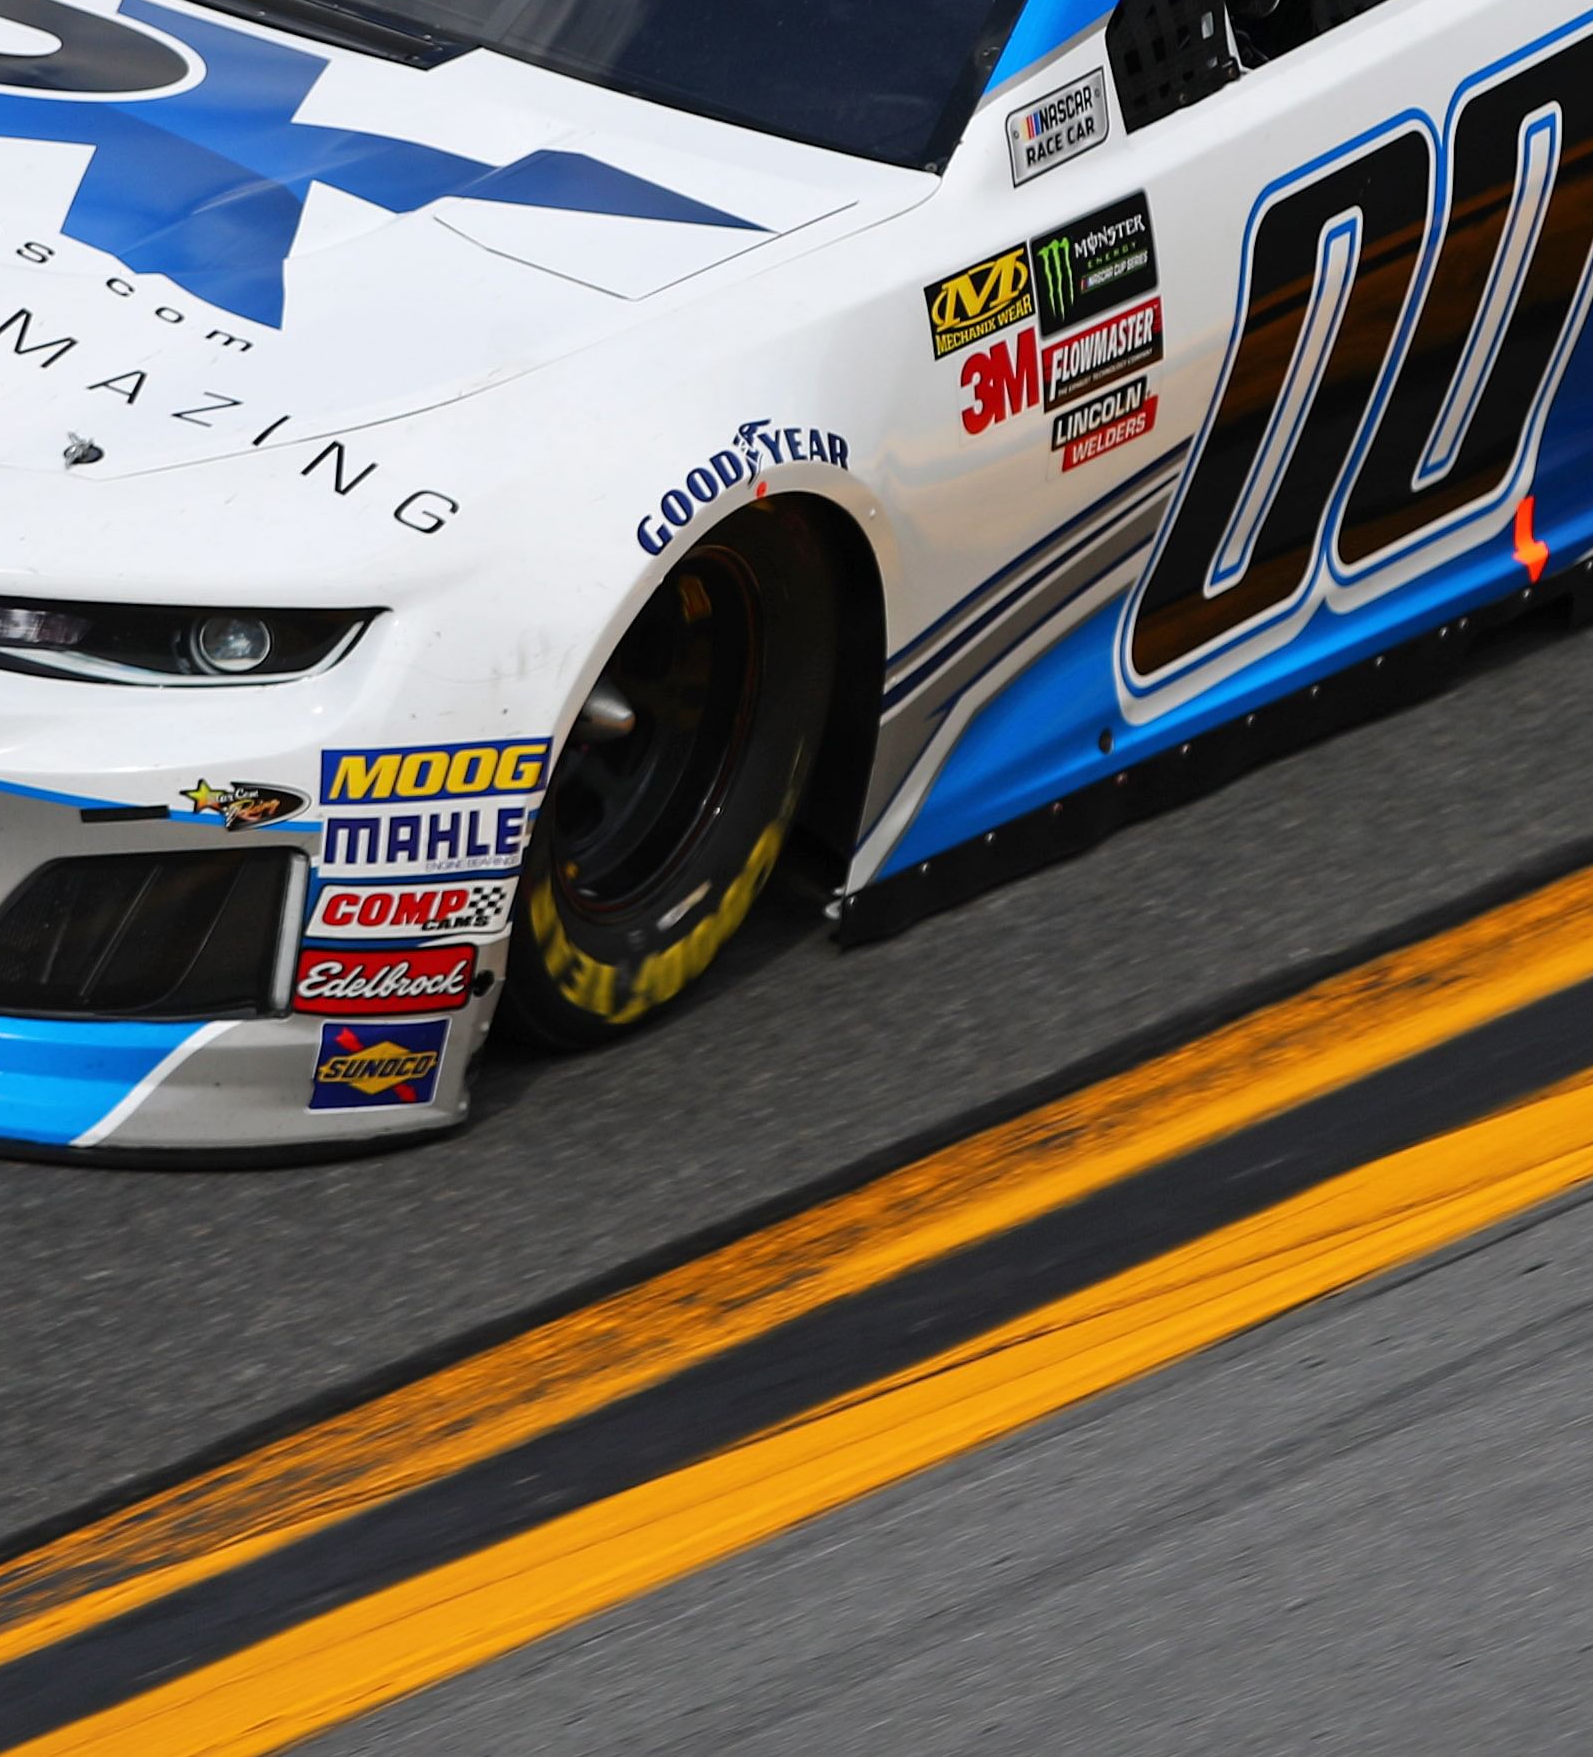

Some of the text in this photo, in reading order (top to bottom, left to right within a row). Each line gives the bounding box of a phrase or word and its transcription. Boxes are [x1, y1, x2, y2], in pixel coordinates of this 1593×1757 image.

[1038, 85, 1094, 134] NASCAR
[1026, 115, 1096, 168] RACE CAR
[1074, 213, 1147, 259] MONSTER
[1087, 241, 1138, 270] ENERGY
[935, 294, 1034, 356] MECHANIX WEAR
[960, 325, 1040, 436] 3M
[1049, 308, 1155, 403] FLOWMASTER
[1055, 381, 1143, 446] LINCOLN
[1071, 411, 1147, 465] WELDERS
[636, 421, 849, 556] GOODYEAR
[328, 744, 548, 801] MOOG
[322, 806, 525, 865] MAHLE
[321, 888, 470, 927] COMP
[420, 915, 491, 932] CAMS
[297, 959, 468, 999] Edelbrock
[323, 1055, 434, 1079] SUNOCO
